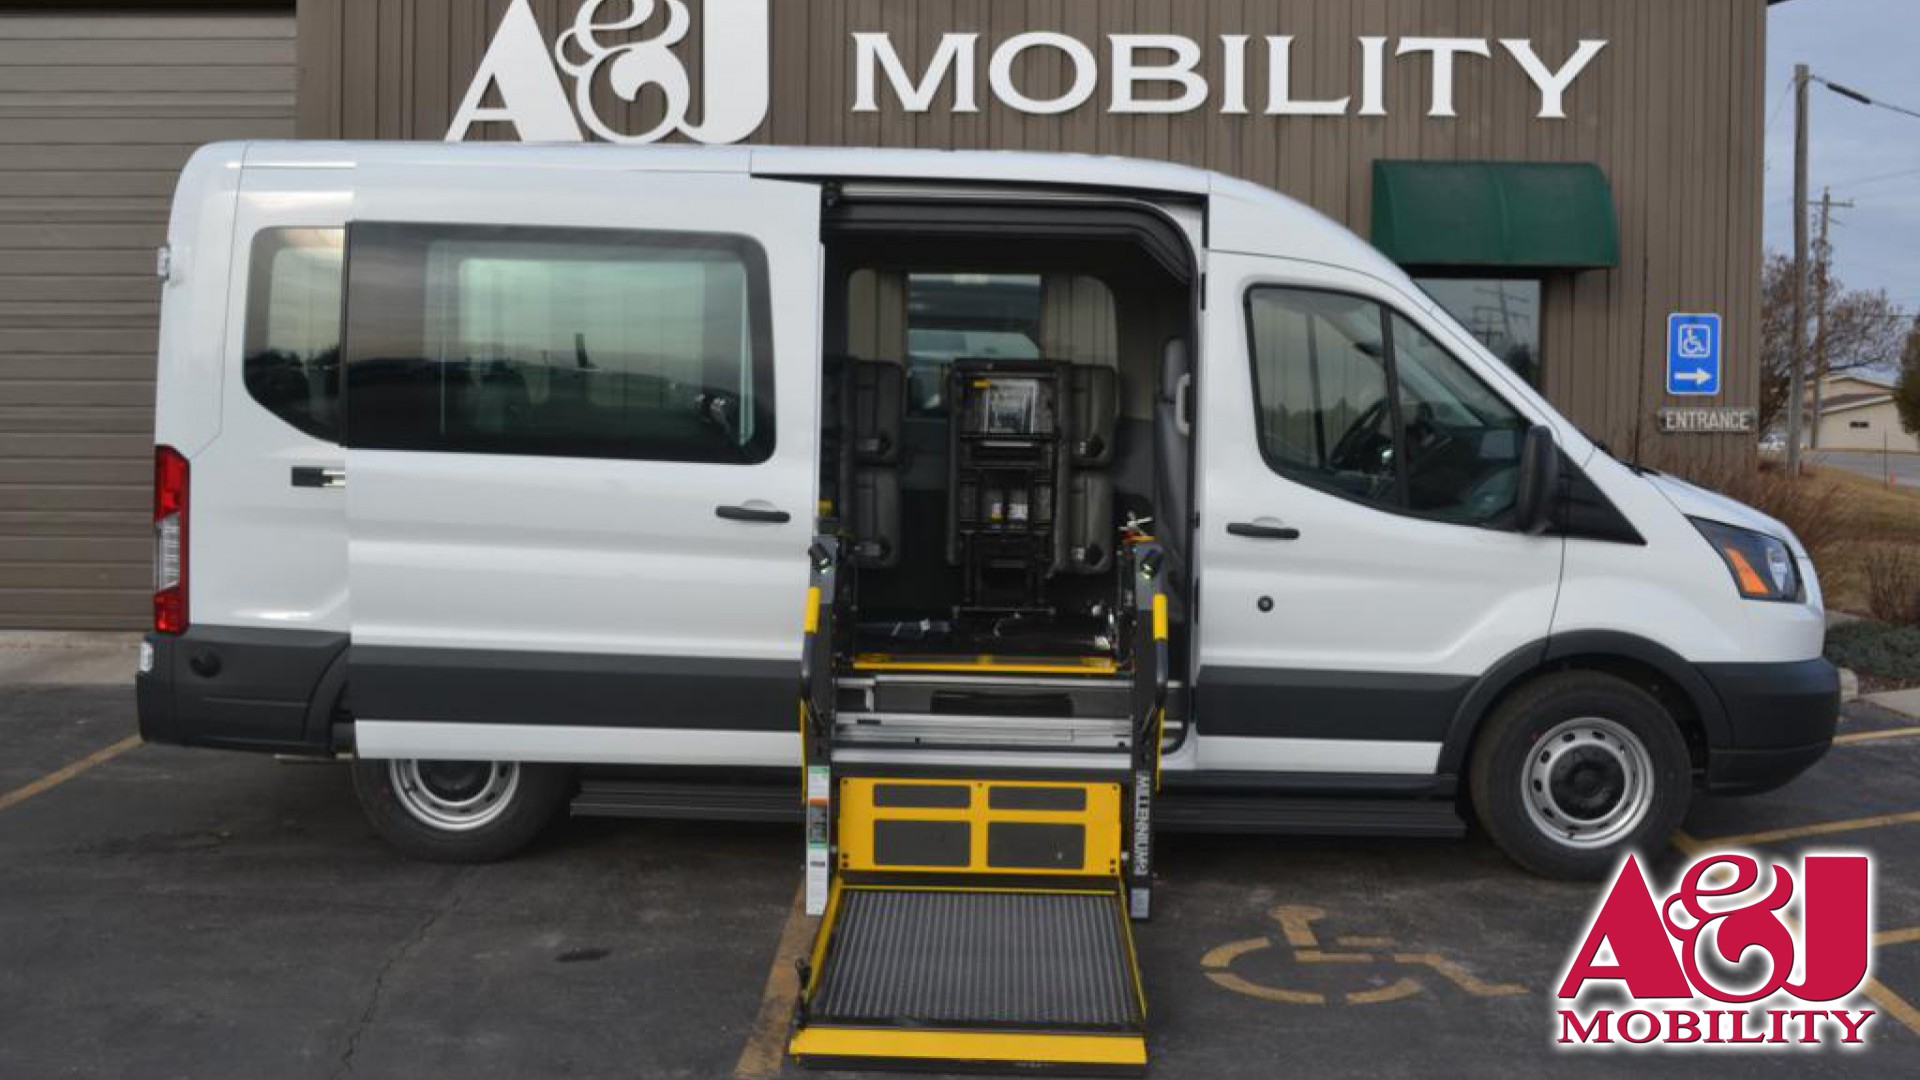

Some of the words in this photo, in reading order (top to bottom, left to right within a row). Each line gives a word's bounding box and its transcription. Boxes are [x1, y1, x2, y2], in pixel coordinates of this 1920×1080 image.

[444, 0, 769, 143] A&J
[852, 31, 1608, 118] MOBILITY
[1666, 411, 1750, 430] ENTRANCE
